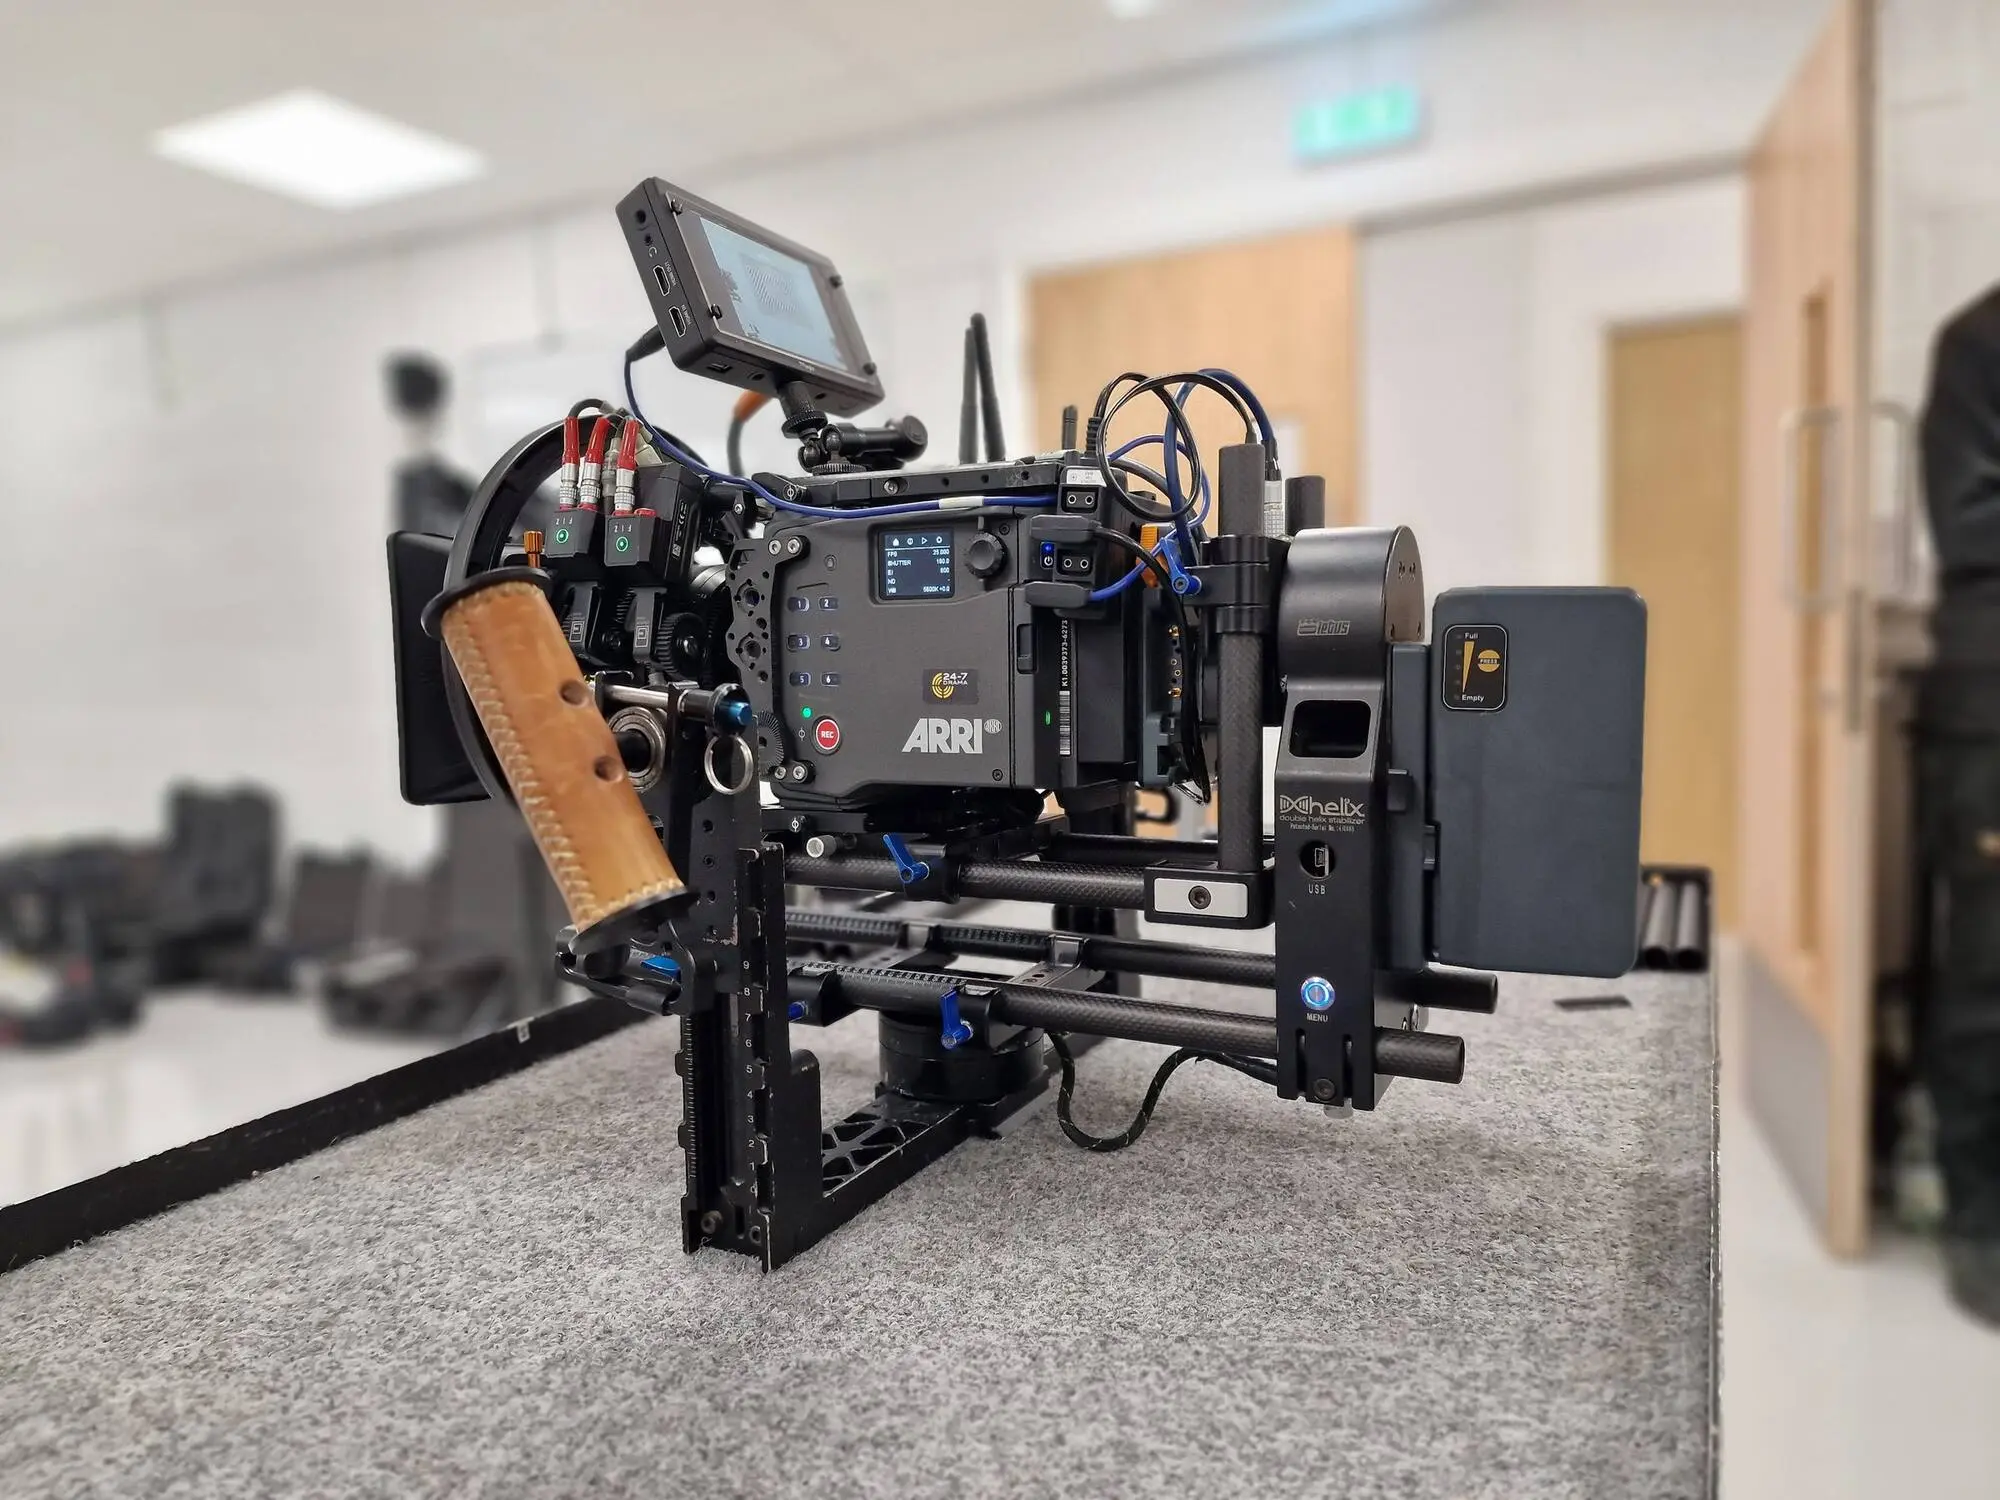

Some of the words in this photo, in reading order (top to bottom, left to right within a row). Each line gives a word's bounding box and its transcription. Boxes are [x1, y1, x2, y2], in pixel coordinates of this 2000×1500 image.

[1464, 632, 1479, 640] Full
[943, 672, 969, 681] 24-7
[1461, 694, 1485, 702] Empty
[821, 730, 835, 739] REC
[901, 718, 983, 754] ARRI
[1279, 814, 1306, 822] double
[1308, 815, 1327, 823] helix
[1328, 816, 1366, 825] stabilizer
[1308, 883, 1326, 895] USB
[743, 960, 750, 969] 9
[744, 987, 751, 996] 8
[744, 1013, 751, 1022] 7
[1306, 1012, 1329, 1023] MENU
[745, 1038, 752, 1048] 6
[746, 1064, 753, 1074] 5
[747, 1090, 753, 1099] 4
[747, 1115, 754, 1124] 3
[748, 1140, 755, 1148] 2
